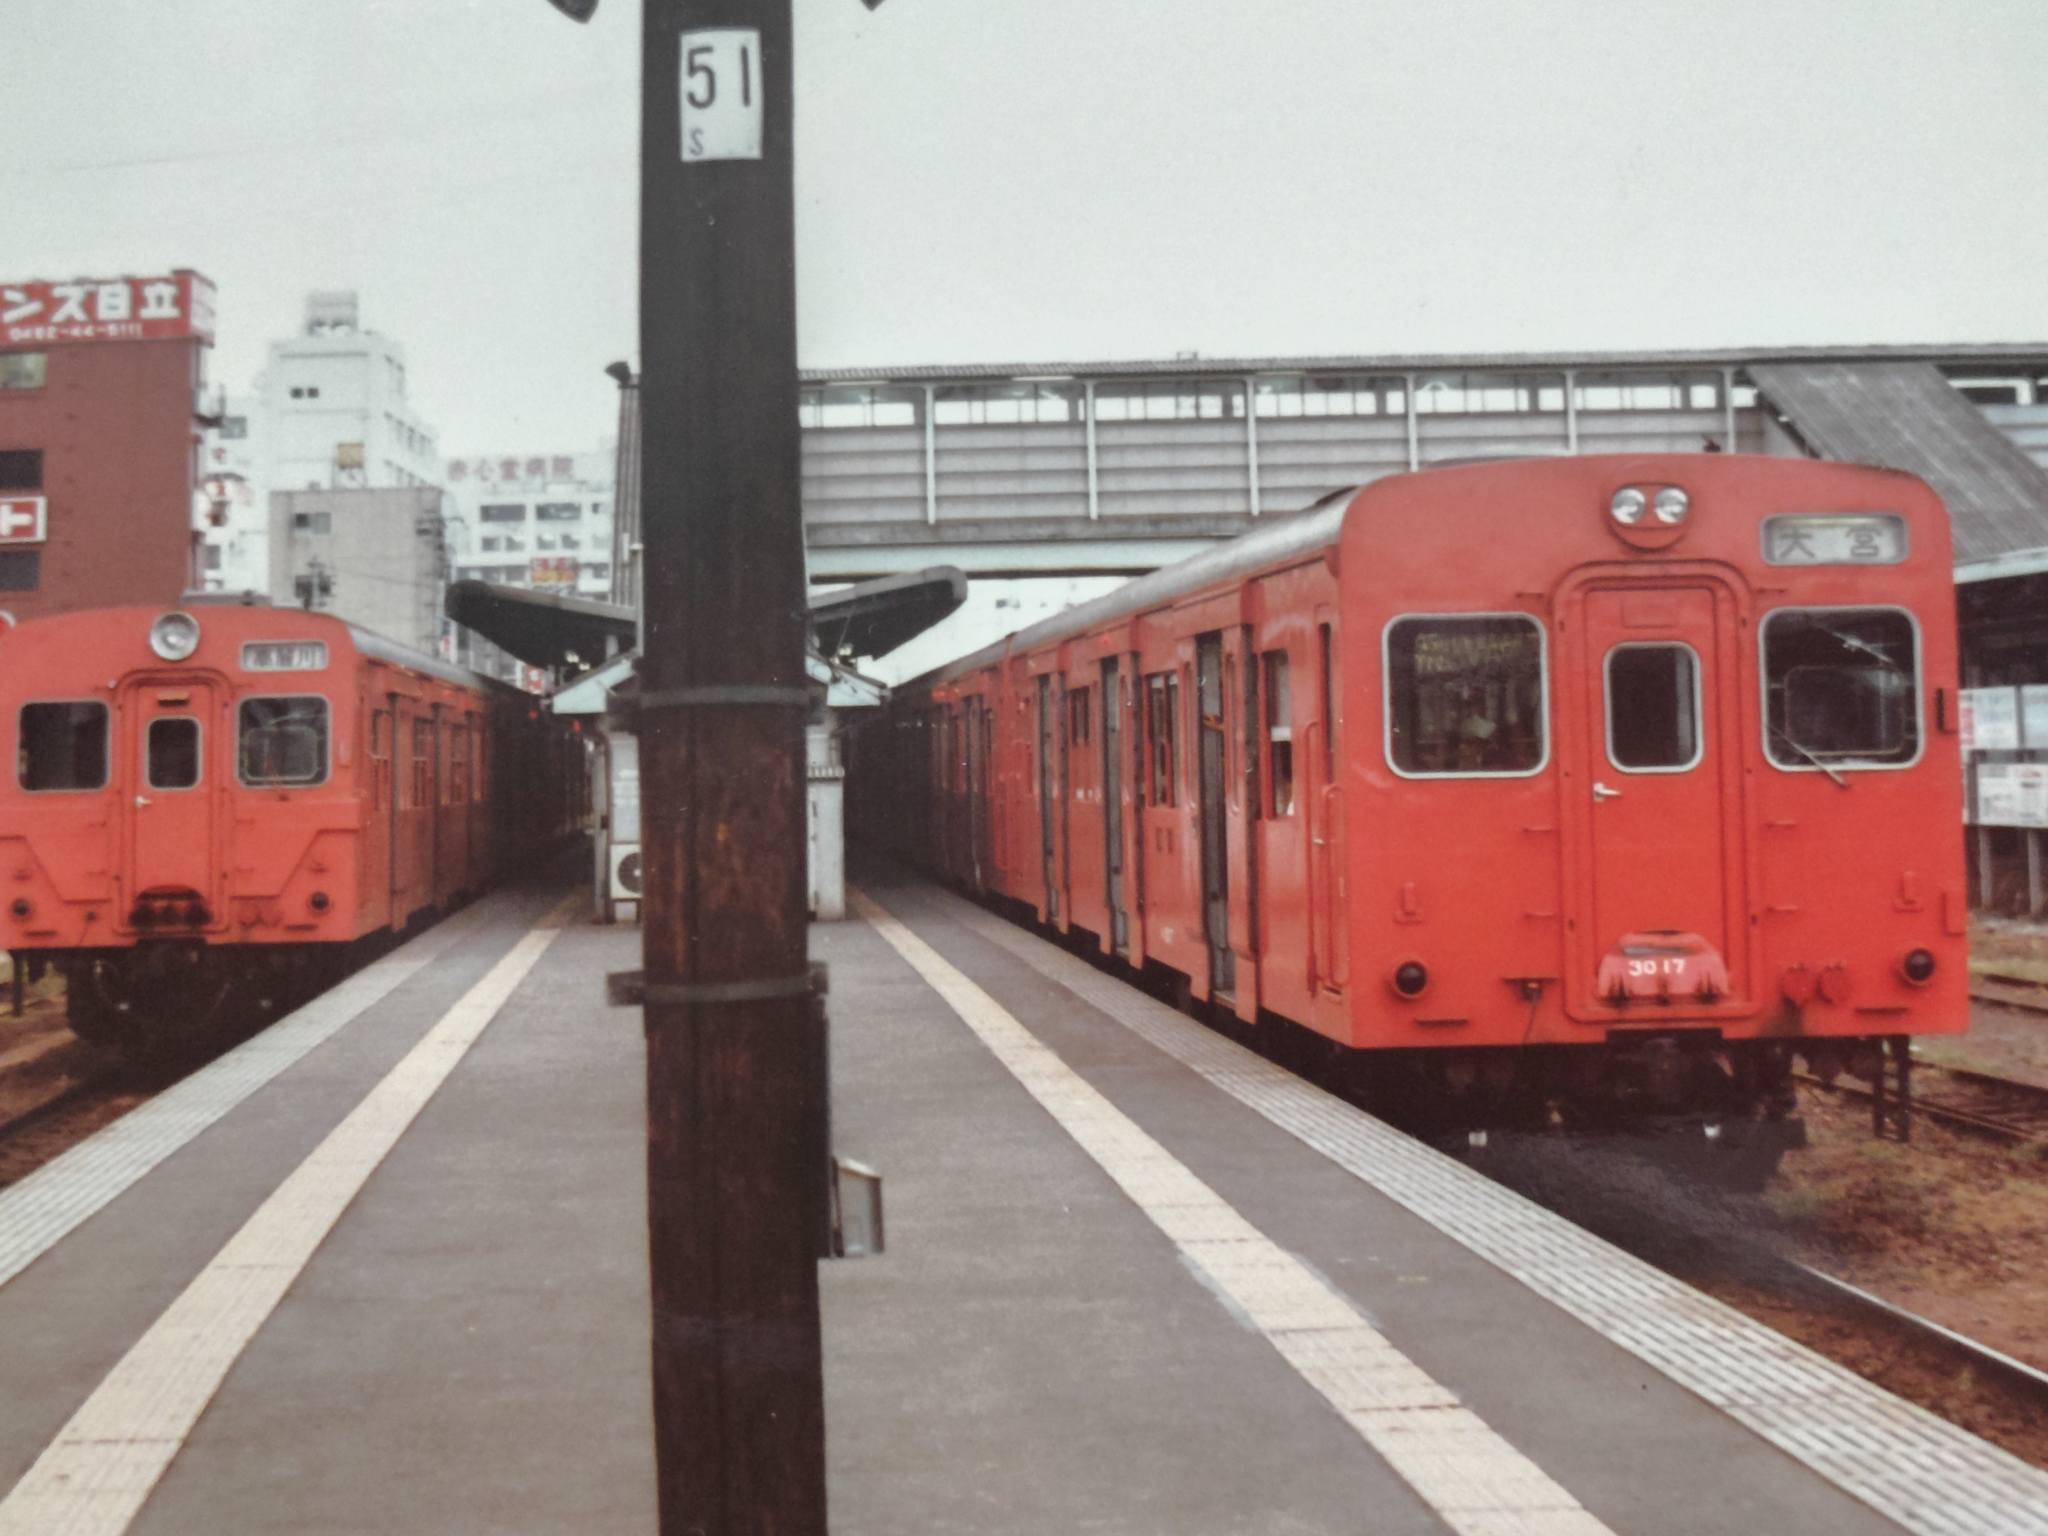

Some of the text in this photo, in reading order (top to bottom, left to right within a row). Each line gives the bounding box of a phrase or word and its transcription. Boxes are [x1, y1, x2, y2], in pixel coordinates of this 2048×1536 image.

[686, 45, 751, 110] 51
[689, 127, 704, 156] S
[1778, 526, 1883, 559] 大宮
[1628, 958, 1686, 977] 3017
